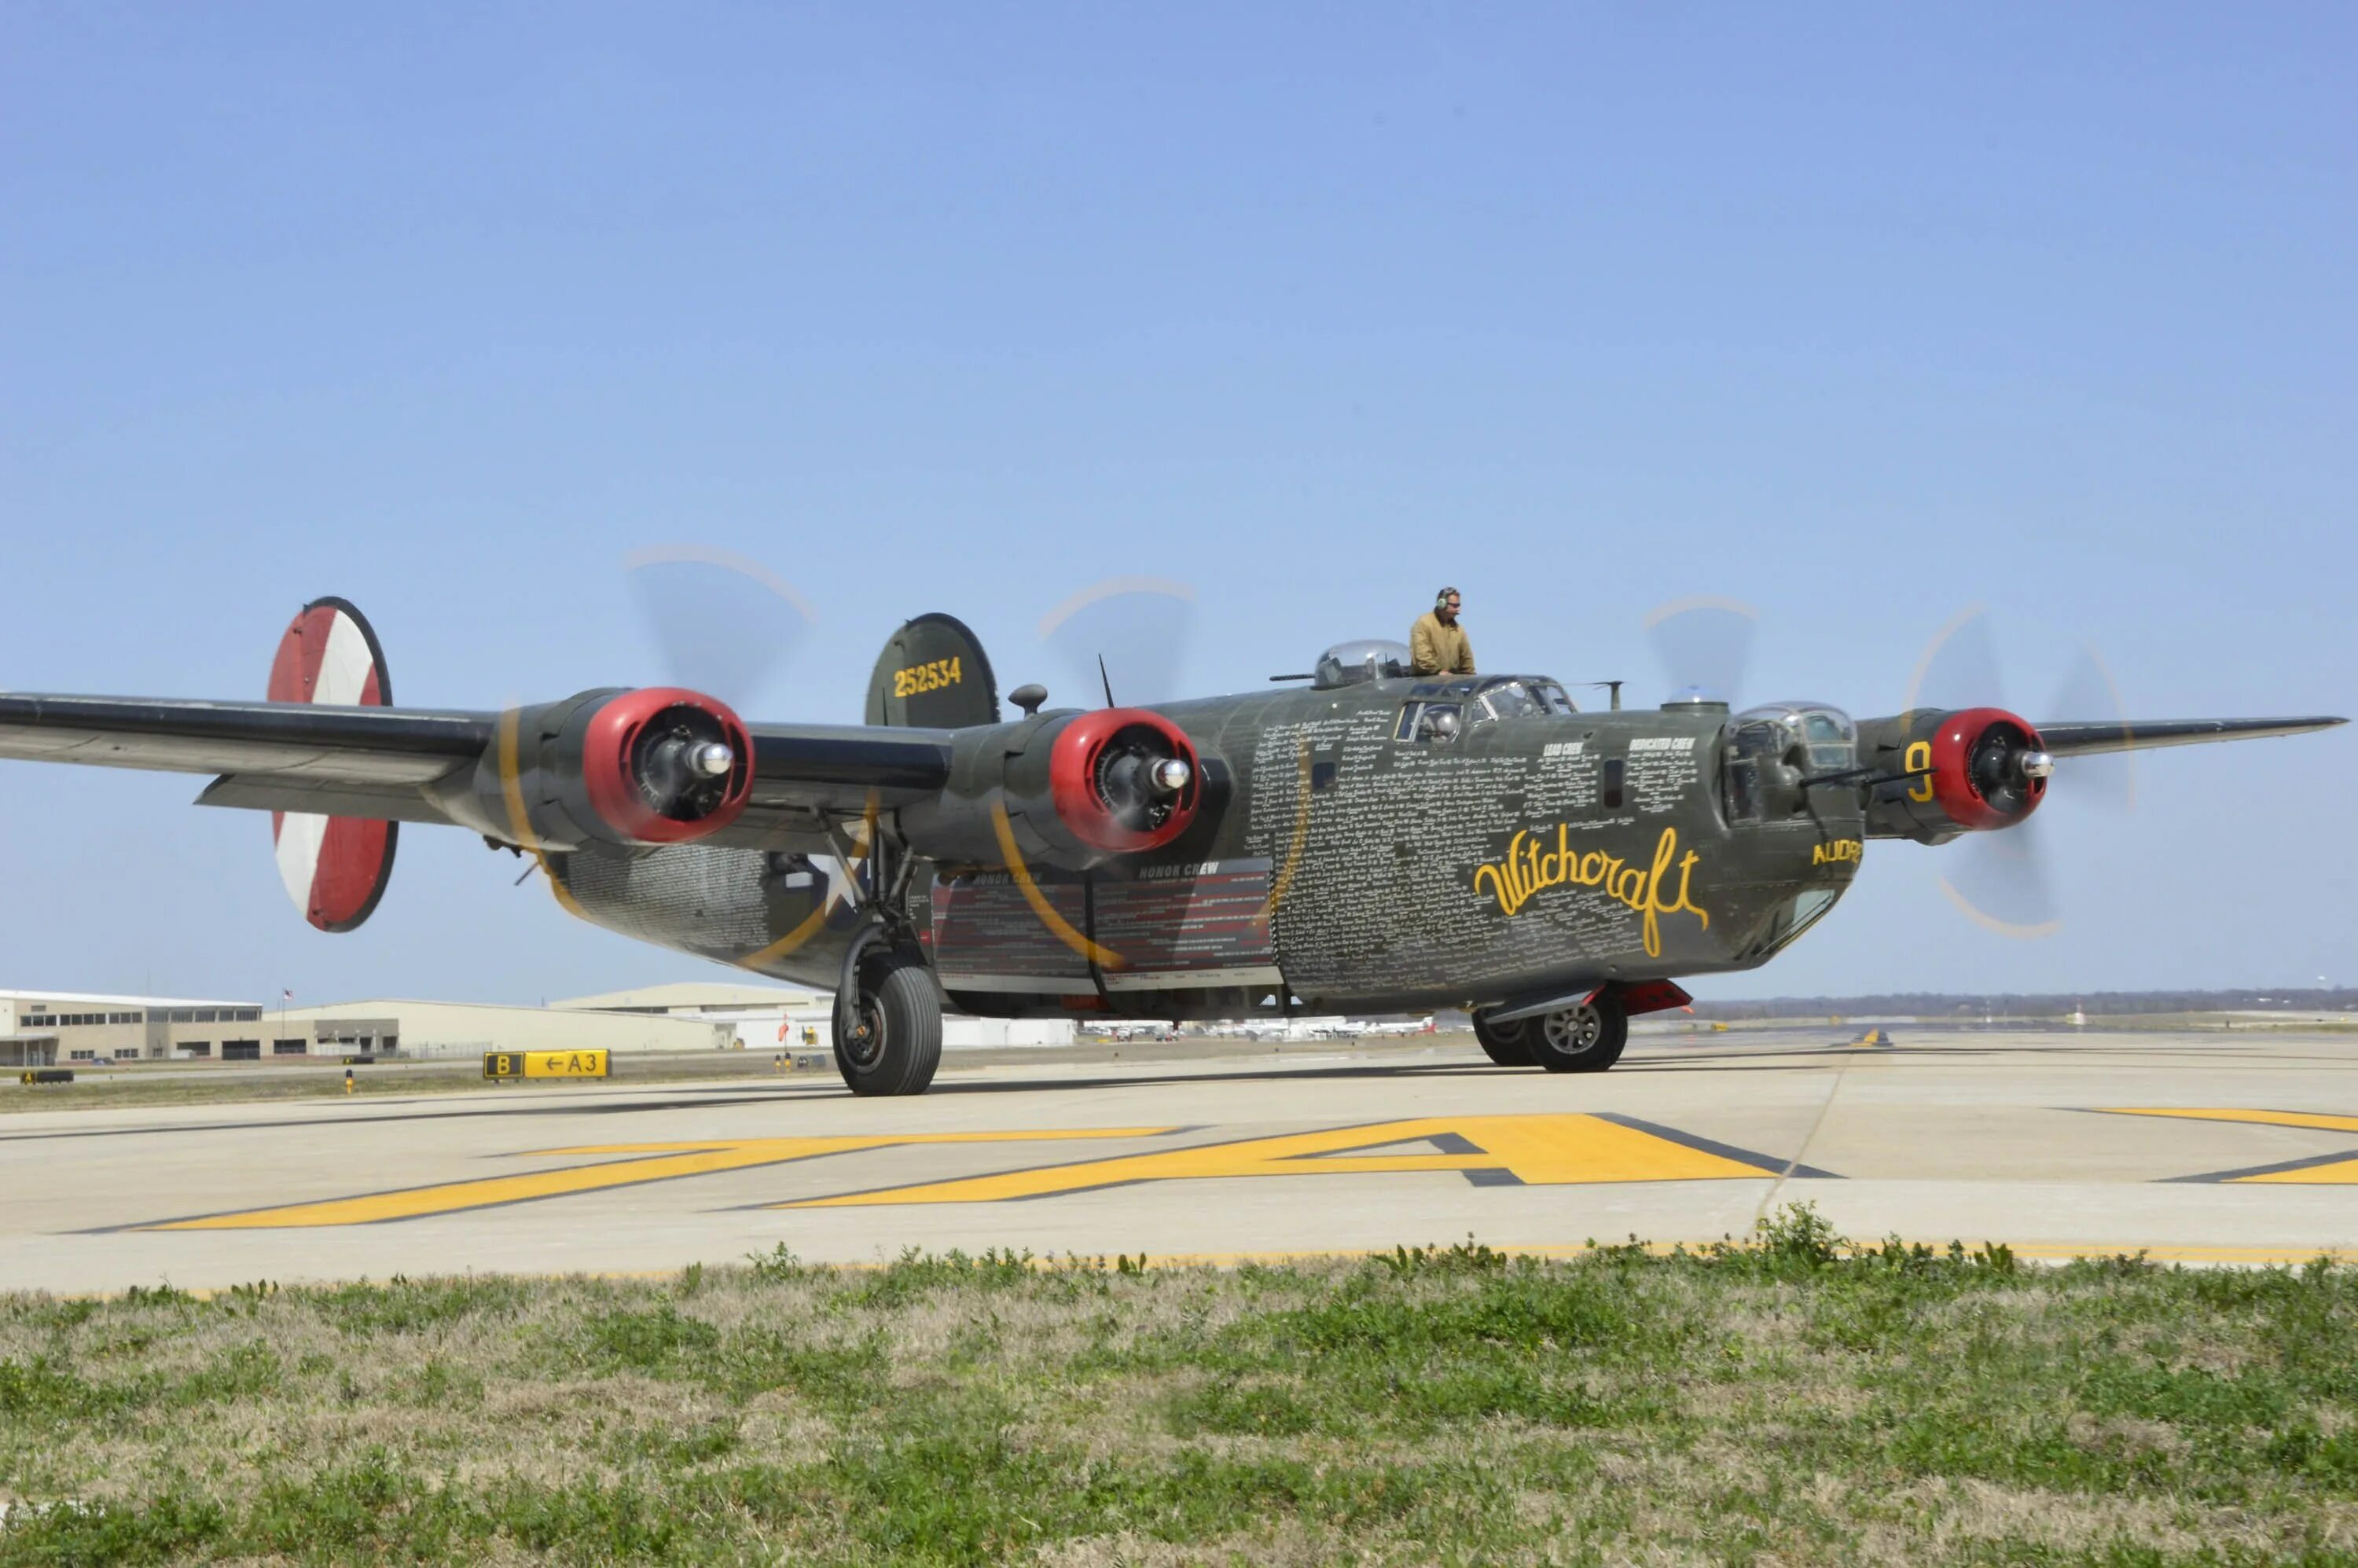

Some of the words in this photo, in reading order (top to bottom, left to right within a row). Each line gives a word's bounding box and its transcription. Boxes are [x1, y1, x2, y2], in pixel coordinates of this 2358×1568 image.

[894, 656, 961, 697] 252534
[1905, 740, 1934, 802] 9
[1139, 864, 1181, 879] HONOR
[1183, 861, 1220, 876] CREW
[1475, 823, 1709, 958] Witchcraft
[498, 1055, 510, 1075] B
[568, 1054, 597, 1073] A3
